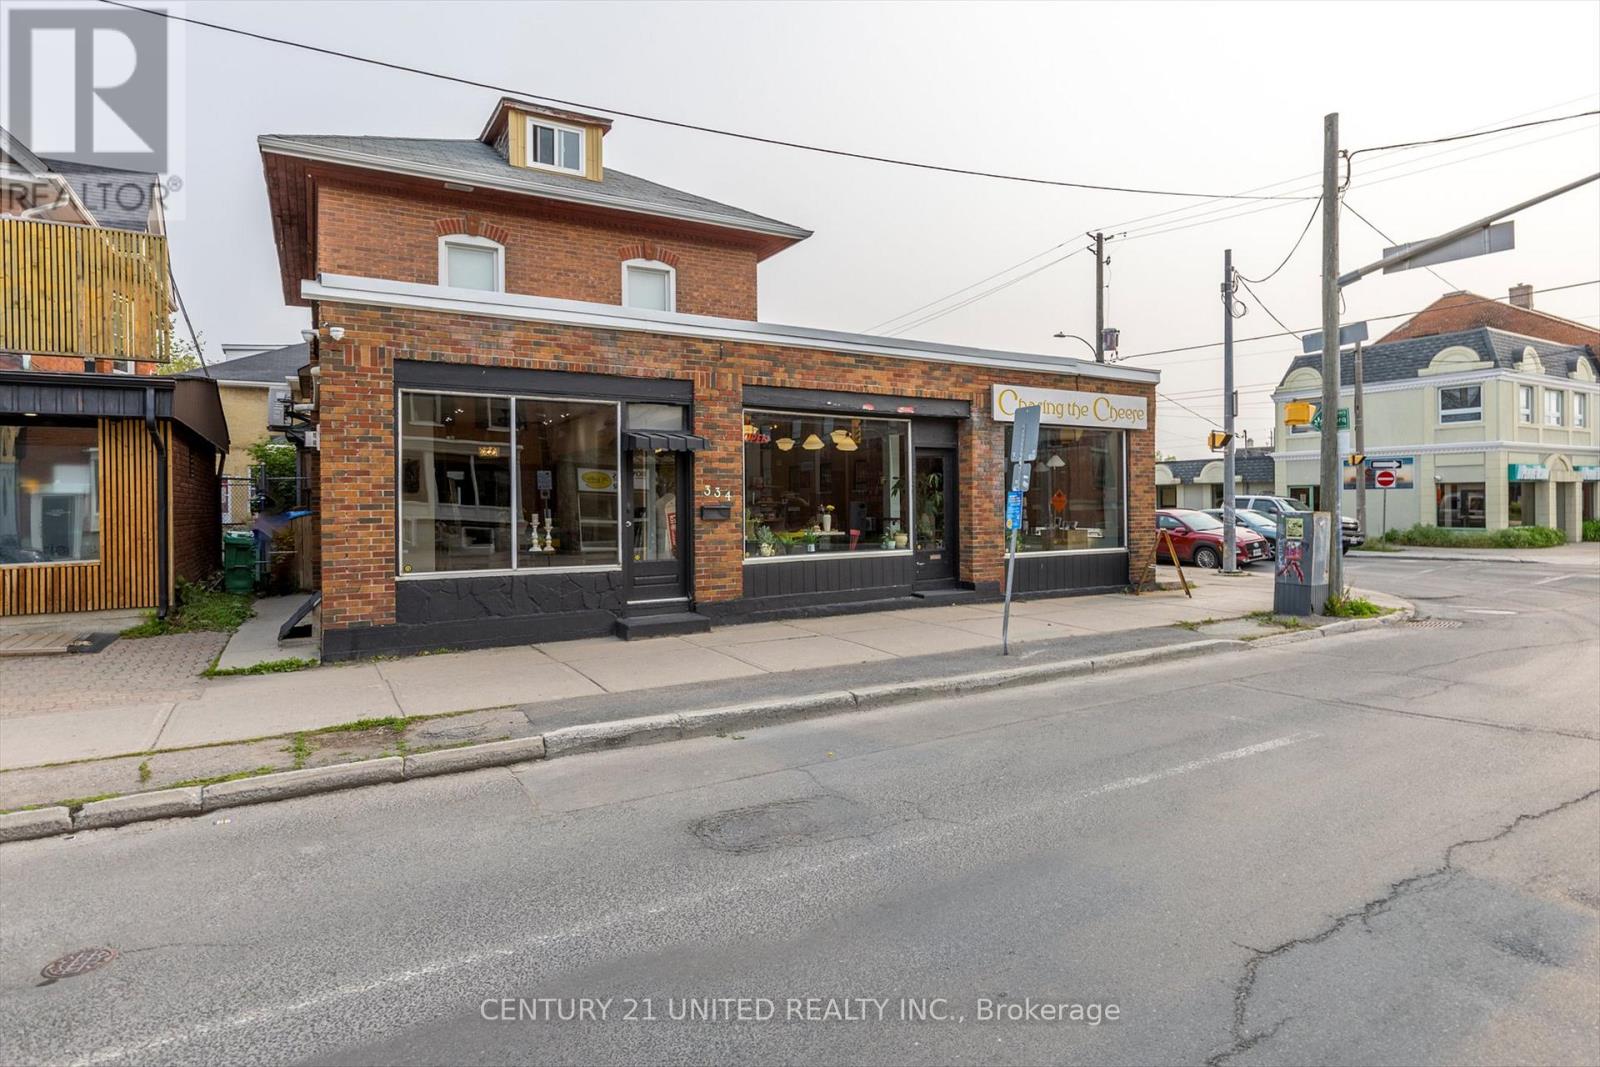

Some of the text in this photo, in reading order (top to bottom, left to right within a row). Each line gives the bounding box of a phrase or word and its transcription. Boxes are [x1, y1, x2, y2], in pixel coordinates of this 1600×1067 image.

[1067, 400, 1089, 420] the
[1093, 397, 1145, 423] Cheese
[703, 484, 732, 502] 334
